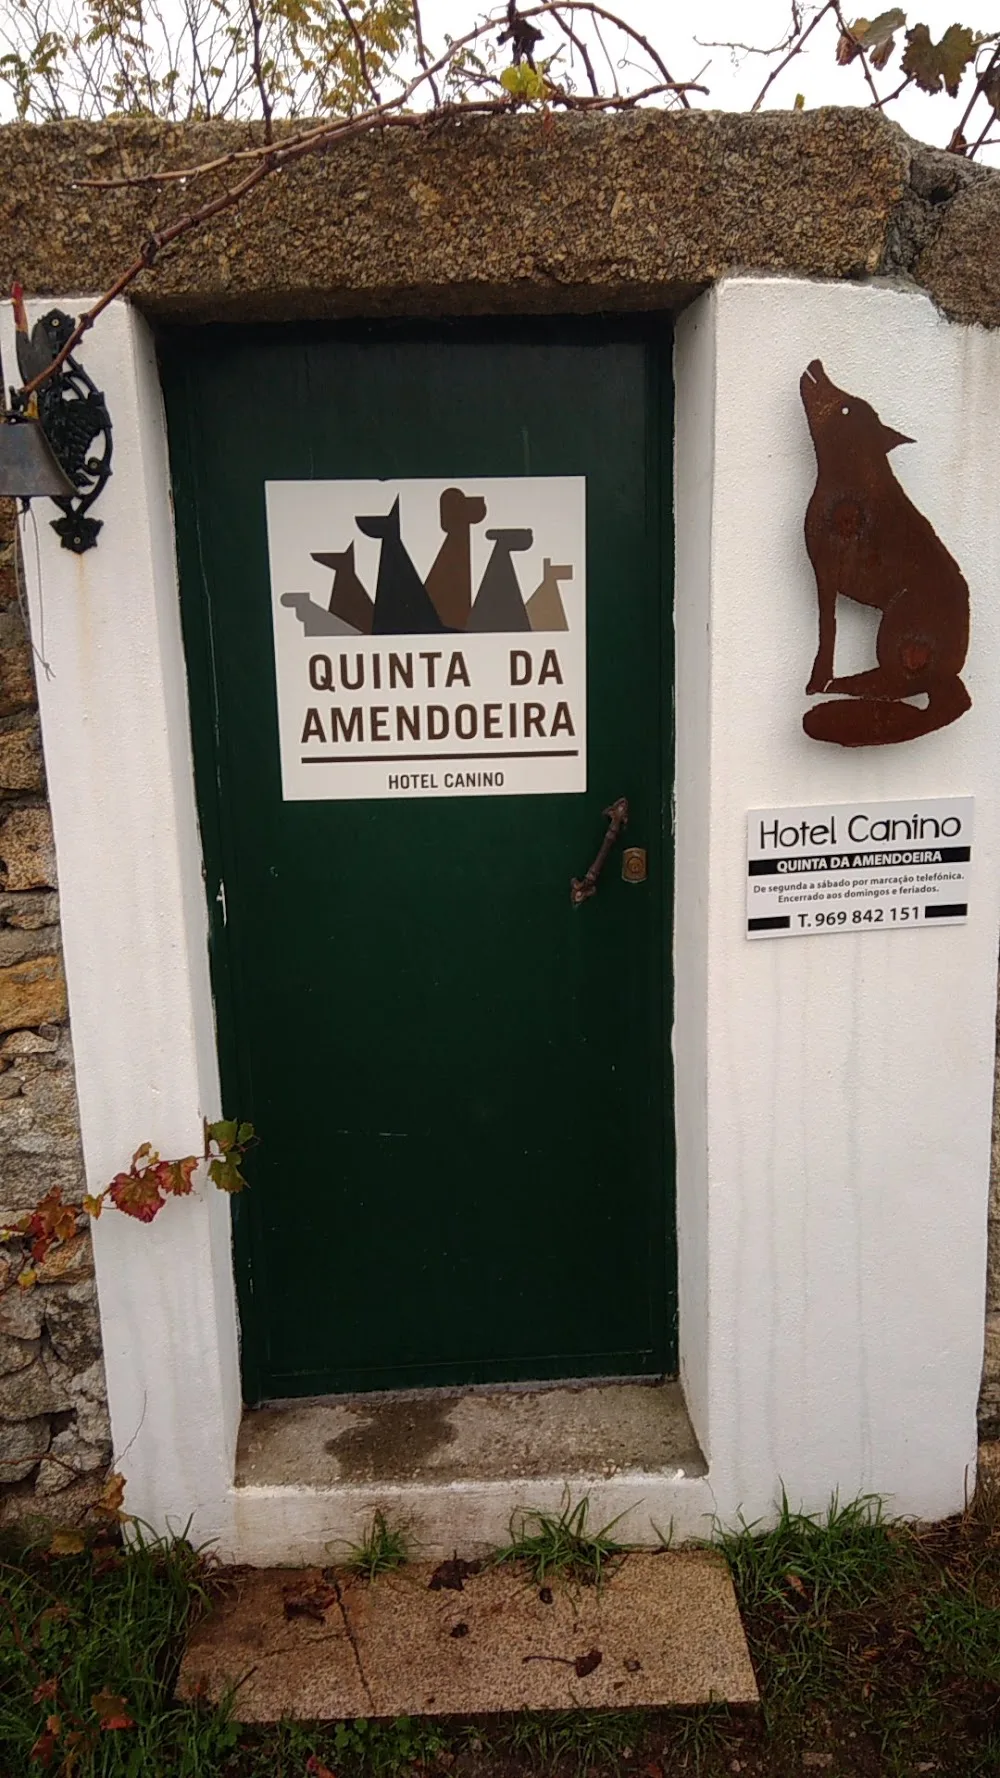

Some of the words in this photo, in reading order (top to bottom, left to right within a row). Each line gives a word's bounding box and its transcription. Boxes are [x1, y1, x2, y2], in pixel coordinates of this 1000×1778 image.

[308, 651, 471, 692] QUINTA
[509, 649, 564, 686] DA
[301, 701, 576, 743] AMENDOEIRA
[388, 774, 438, 789] HOTEL
[444, 772, 504, 788] CANINO
[760, 816, 837, 849] Hotel
[848, 813, 962, 842] Canino
[776, 859, 827, 874] QUINTA
[830, 857, 850, 869] DA
[852, 850, 942, 867] AMENDOEIRA
[753, 885, 767, 893] De
[768, 881, 808, 892] segunda
[817, 878, 851, 888] sábado
[852, 879, 868, 887] por
[870, 875, 914, 885] marcação
[778, 892, 825, 903] Encerrado
[844, 886, 890, 898] domingos
[899, 884, 940, 895] feriados.
[851, 908, 884, 924] 842
[889, 906, 919, 921] 151
